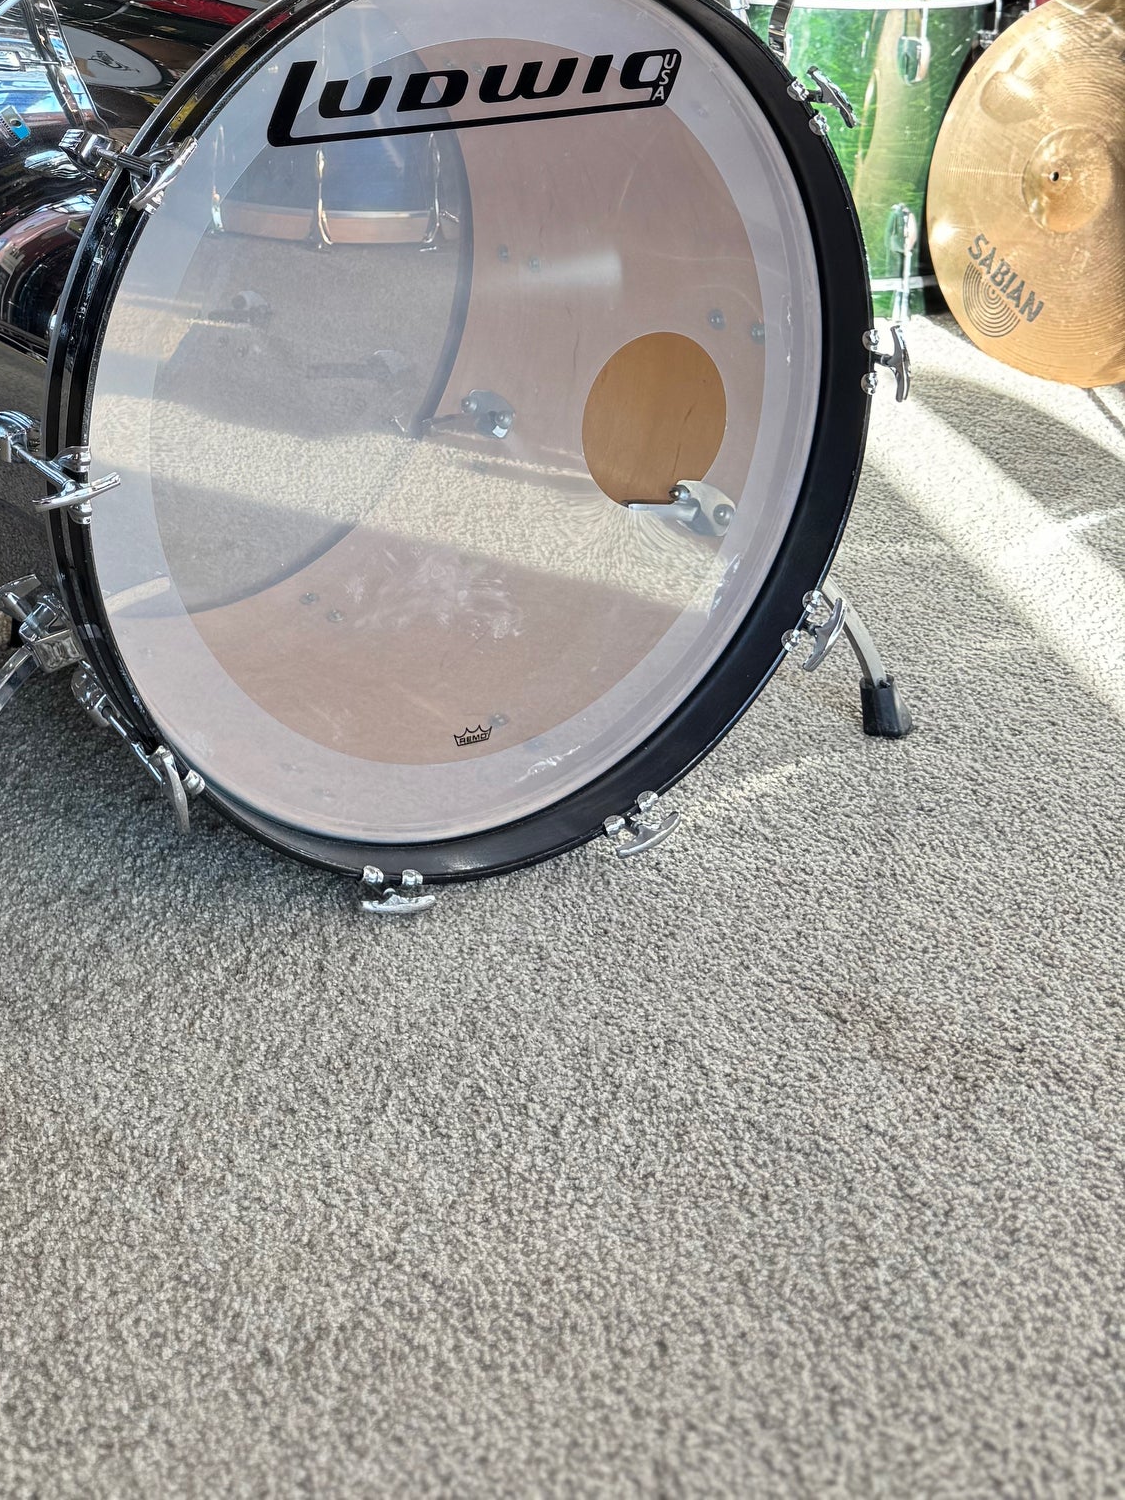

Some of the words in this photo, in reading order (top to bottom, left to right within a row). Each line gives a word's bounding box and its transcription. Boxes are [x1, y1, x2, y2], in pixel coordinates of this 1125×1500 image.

[651, 53, 678, 101] USA
[967, 232, 1045, 323] SABIAN
[458, 732, 489, 744] REMO
